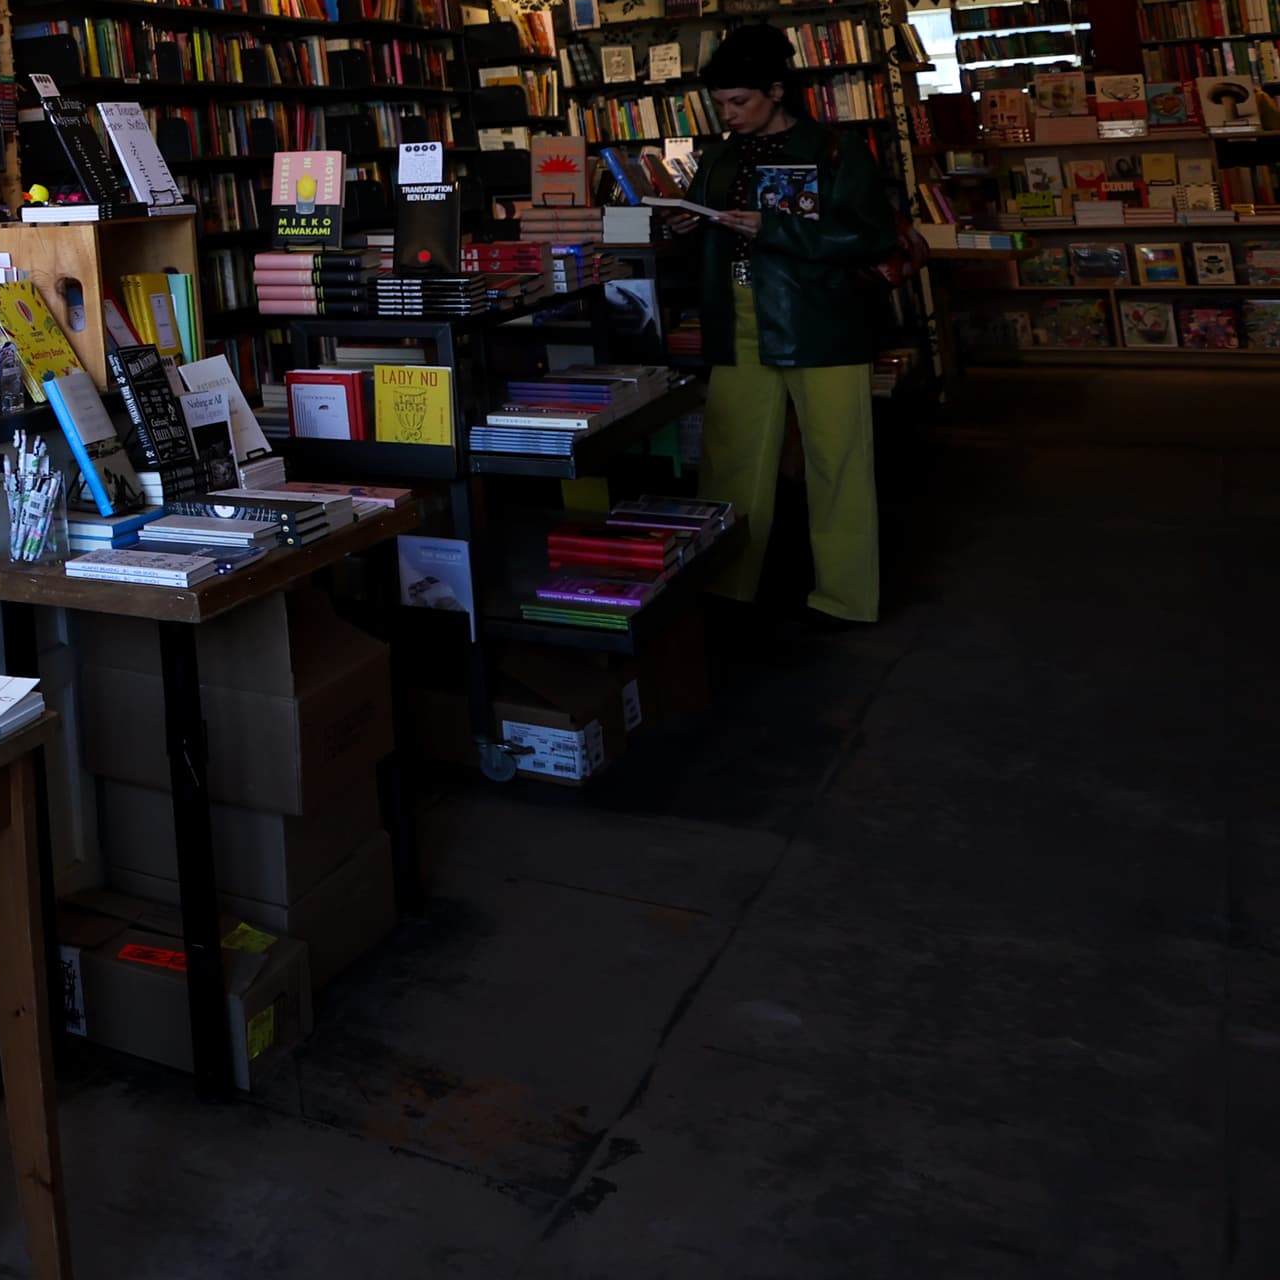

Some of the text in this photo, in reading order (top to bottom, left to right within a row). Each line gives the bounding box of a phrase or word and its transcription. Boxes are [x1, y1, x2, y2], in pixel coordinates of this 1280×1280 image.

[280, 155, 335, 201] SISTERS IN YELLOW
[401, 184, 454, 195] TRANSCRIPTION
[406, 192, 447, 202] BEN LERNER
[278, 218, 332, 227] MIEKO
[277, 227, 332, 236] KAWAKAMI
[381, 368, 439, 388] LADY NO
